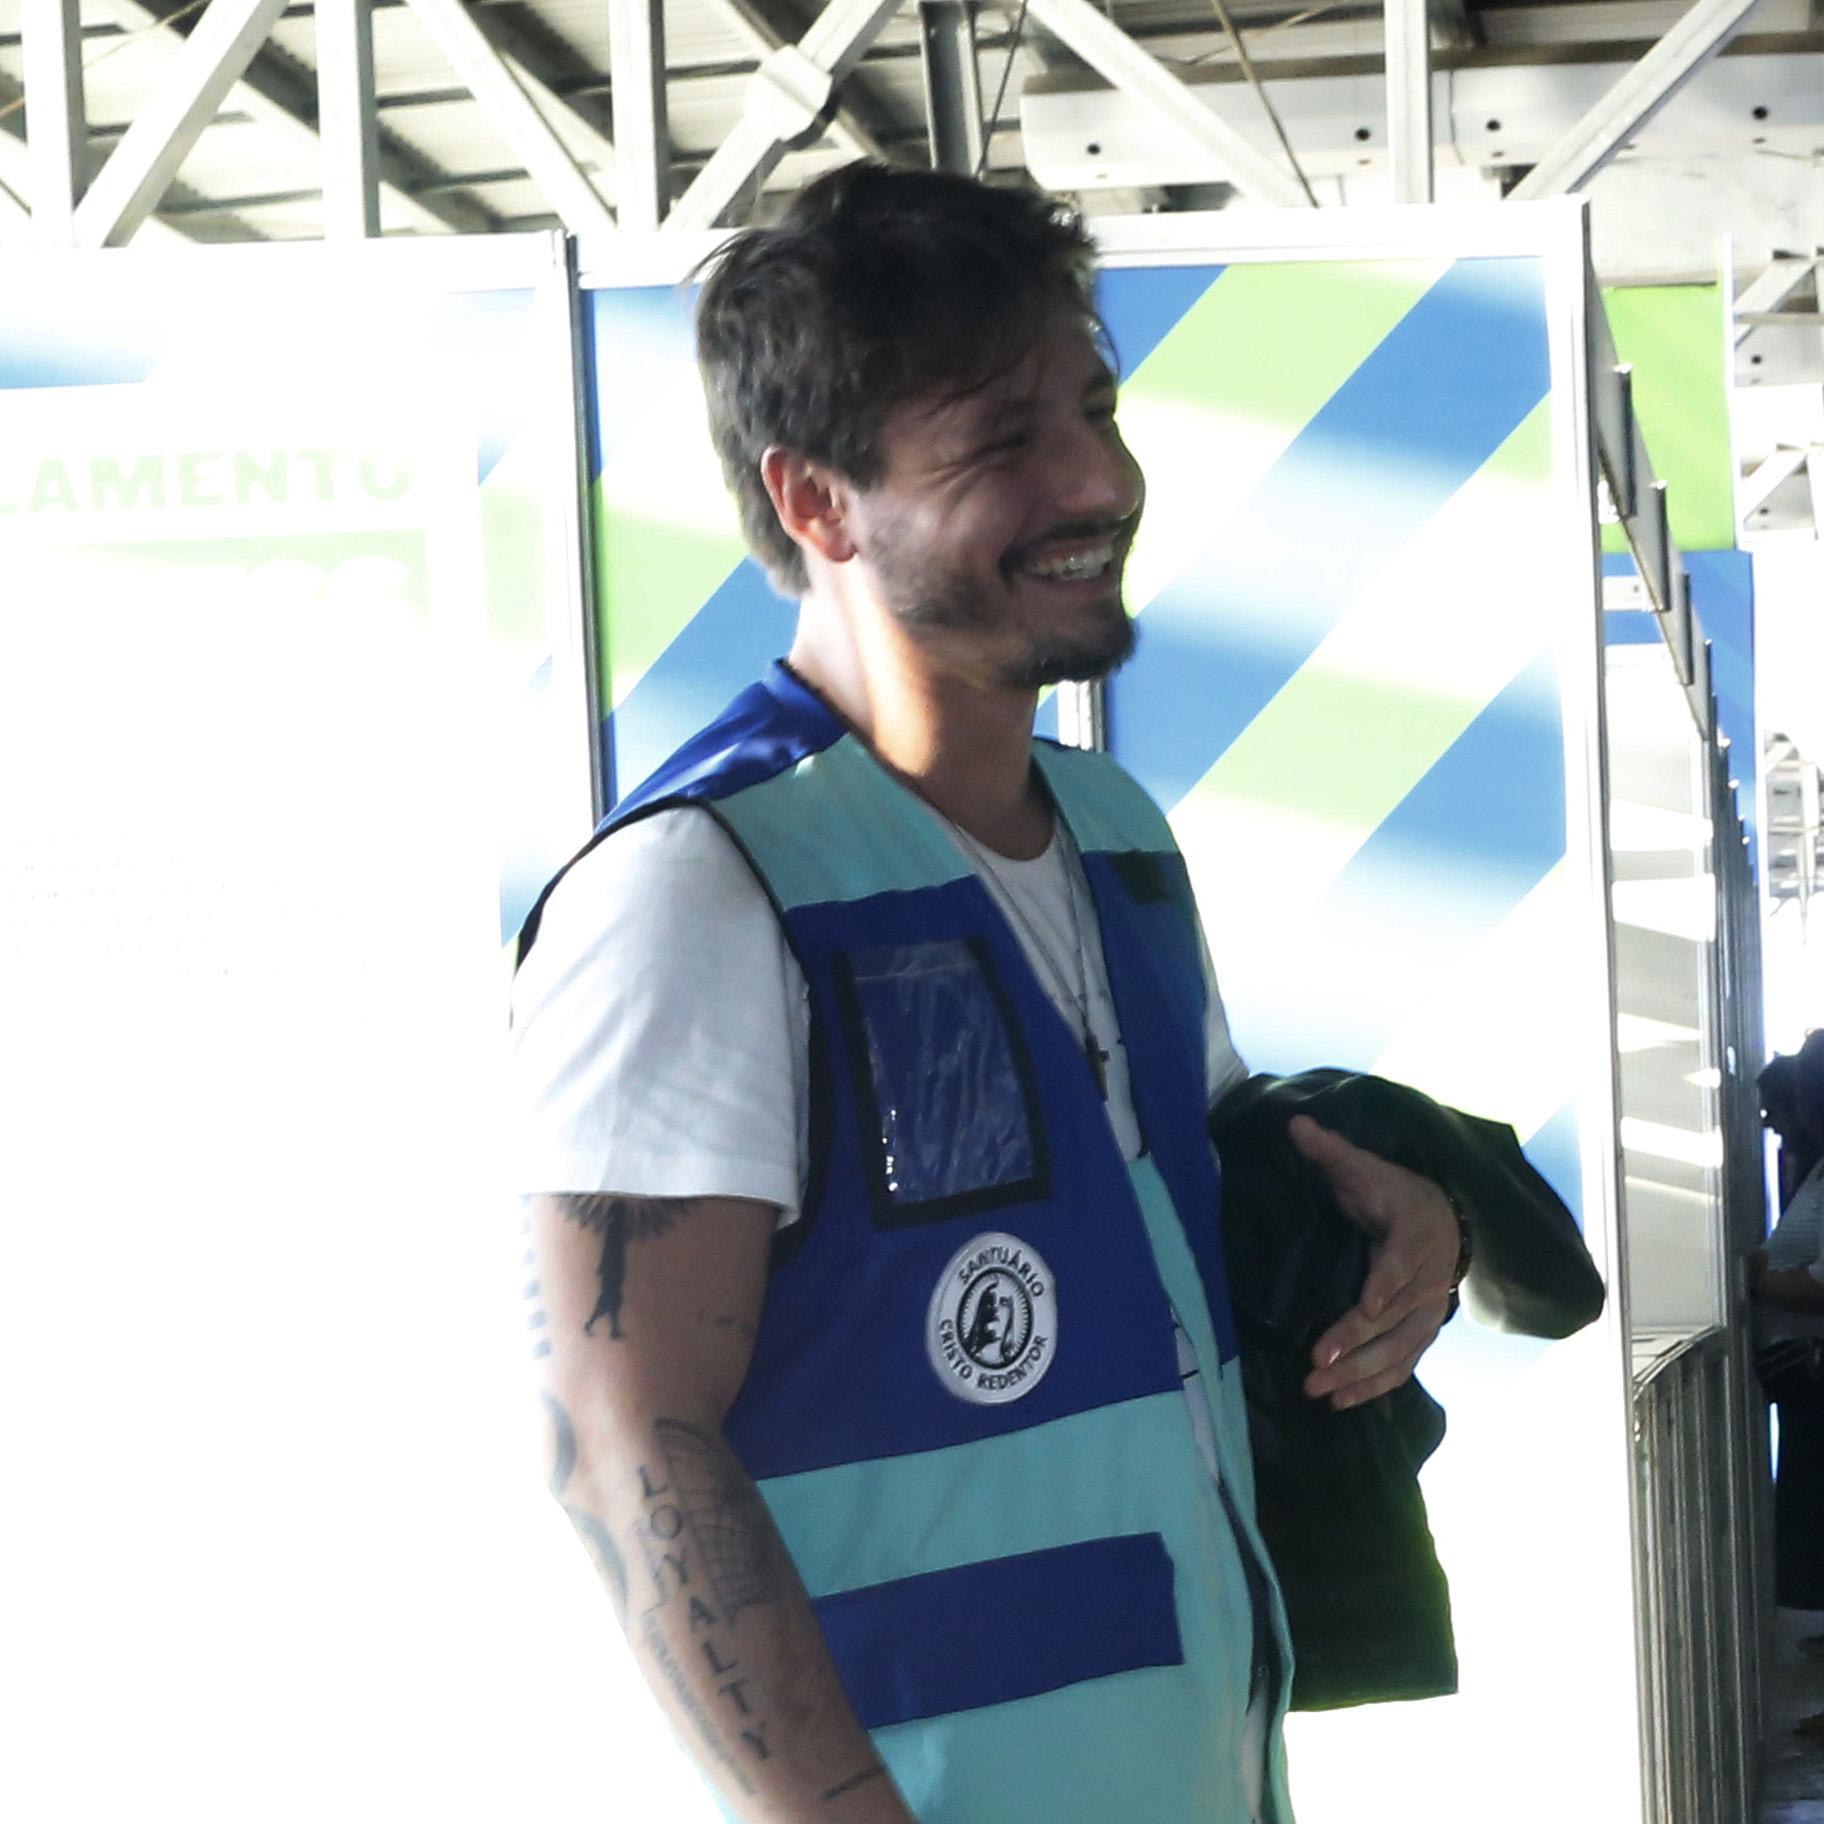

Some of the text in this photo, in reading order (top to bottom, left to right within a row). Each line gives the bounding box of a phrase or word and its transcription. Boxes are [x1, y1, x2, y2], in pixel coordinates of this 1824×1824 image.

[958, 1246, 1045, 1298] SANTUÁRIO
[940, 1318, 1048, 1390] CRISTO REDENTOR
